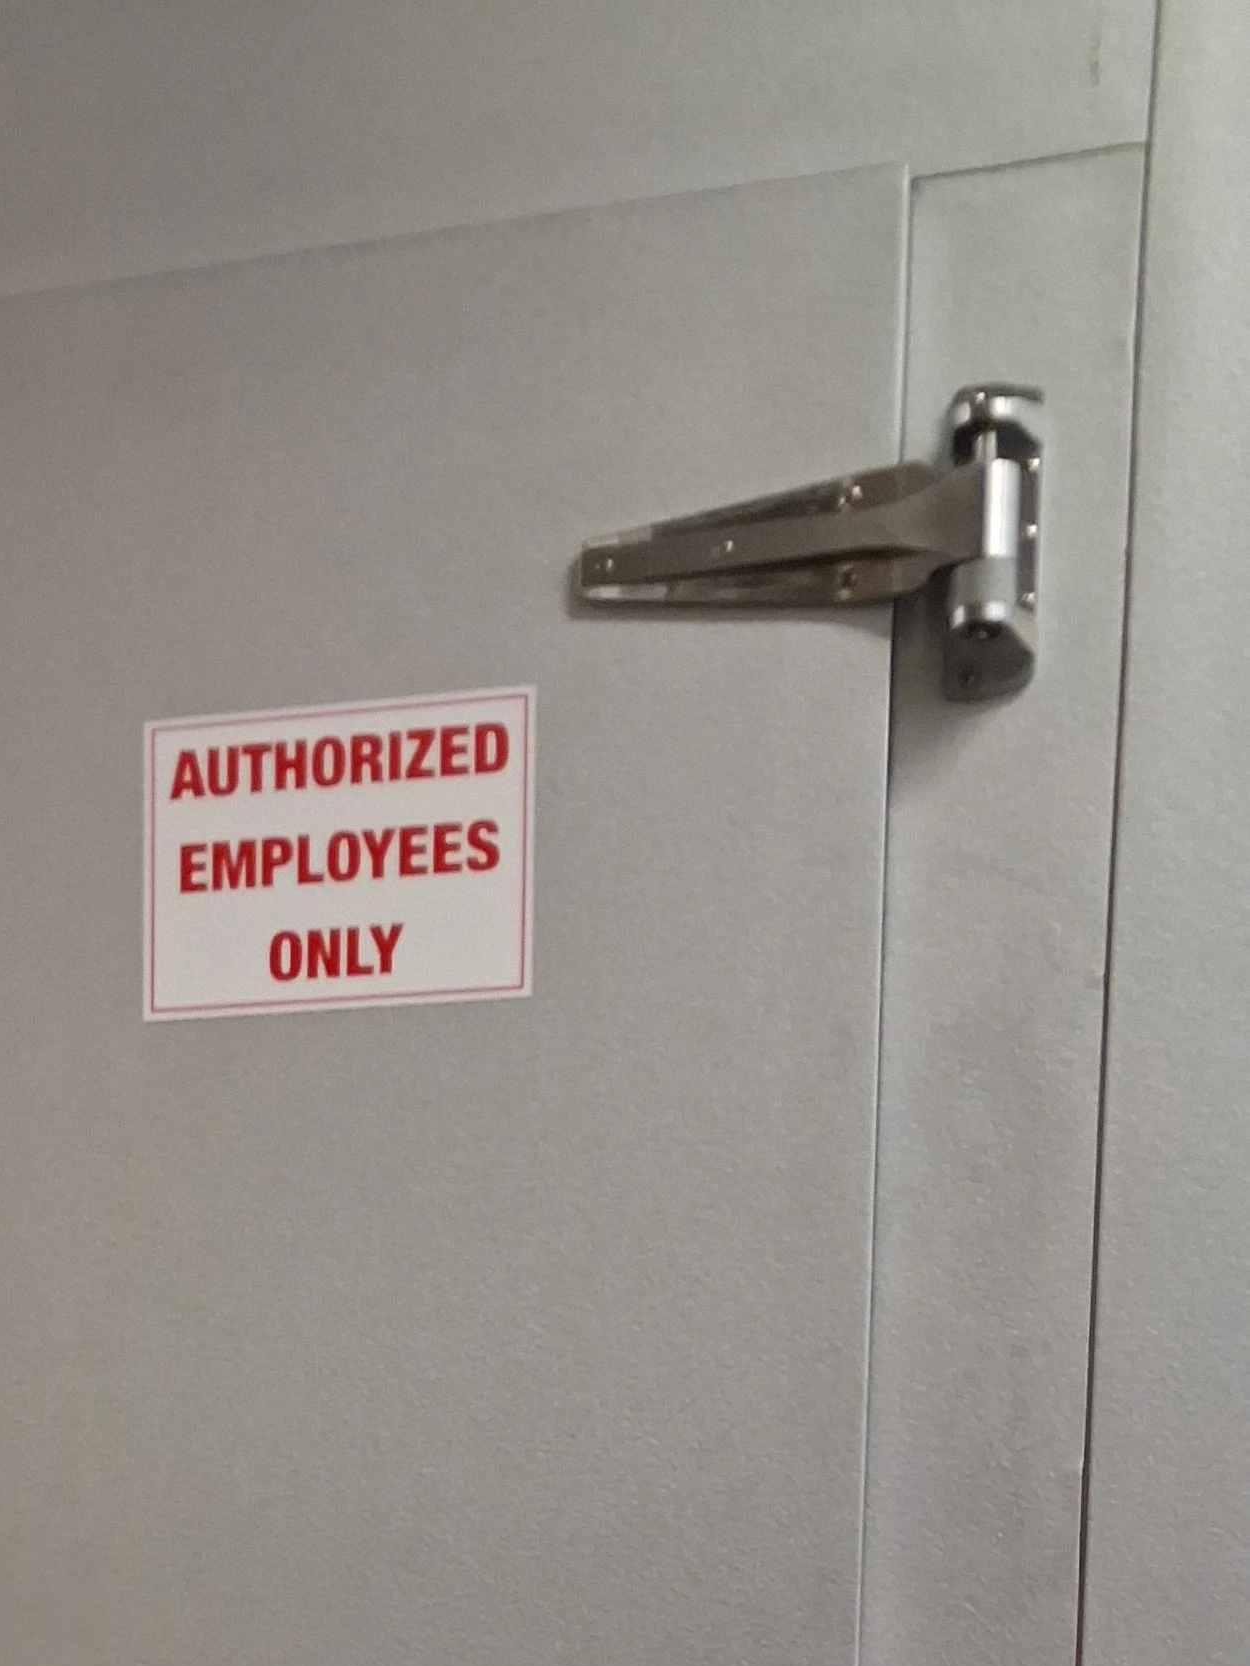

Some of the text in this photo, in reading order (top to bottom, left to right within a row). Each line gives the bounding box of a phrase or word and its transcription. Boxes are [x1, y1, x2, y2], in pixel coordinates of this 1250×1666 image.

[169, 722, 510, 801] AUTHORIZED
[179, 819, 501, 894] EMPLOYEES
[268, 923, 404, 983] ONLY
